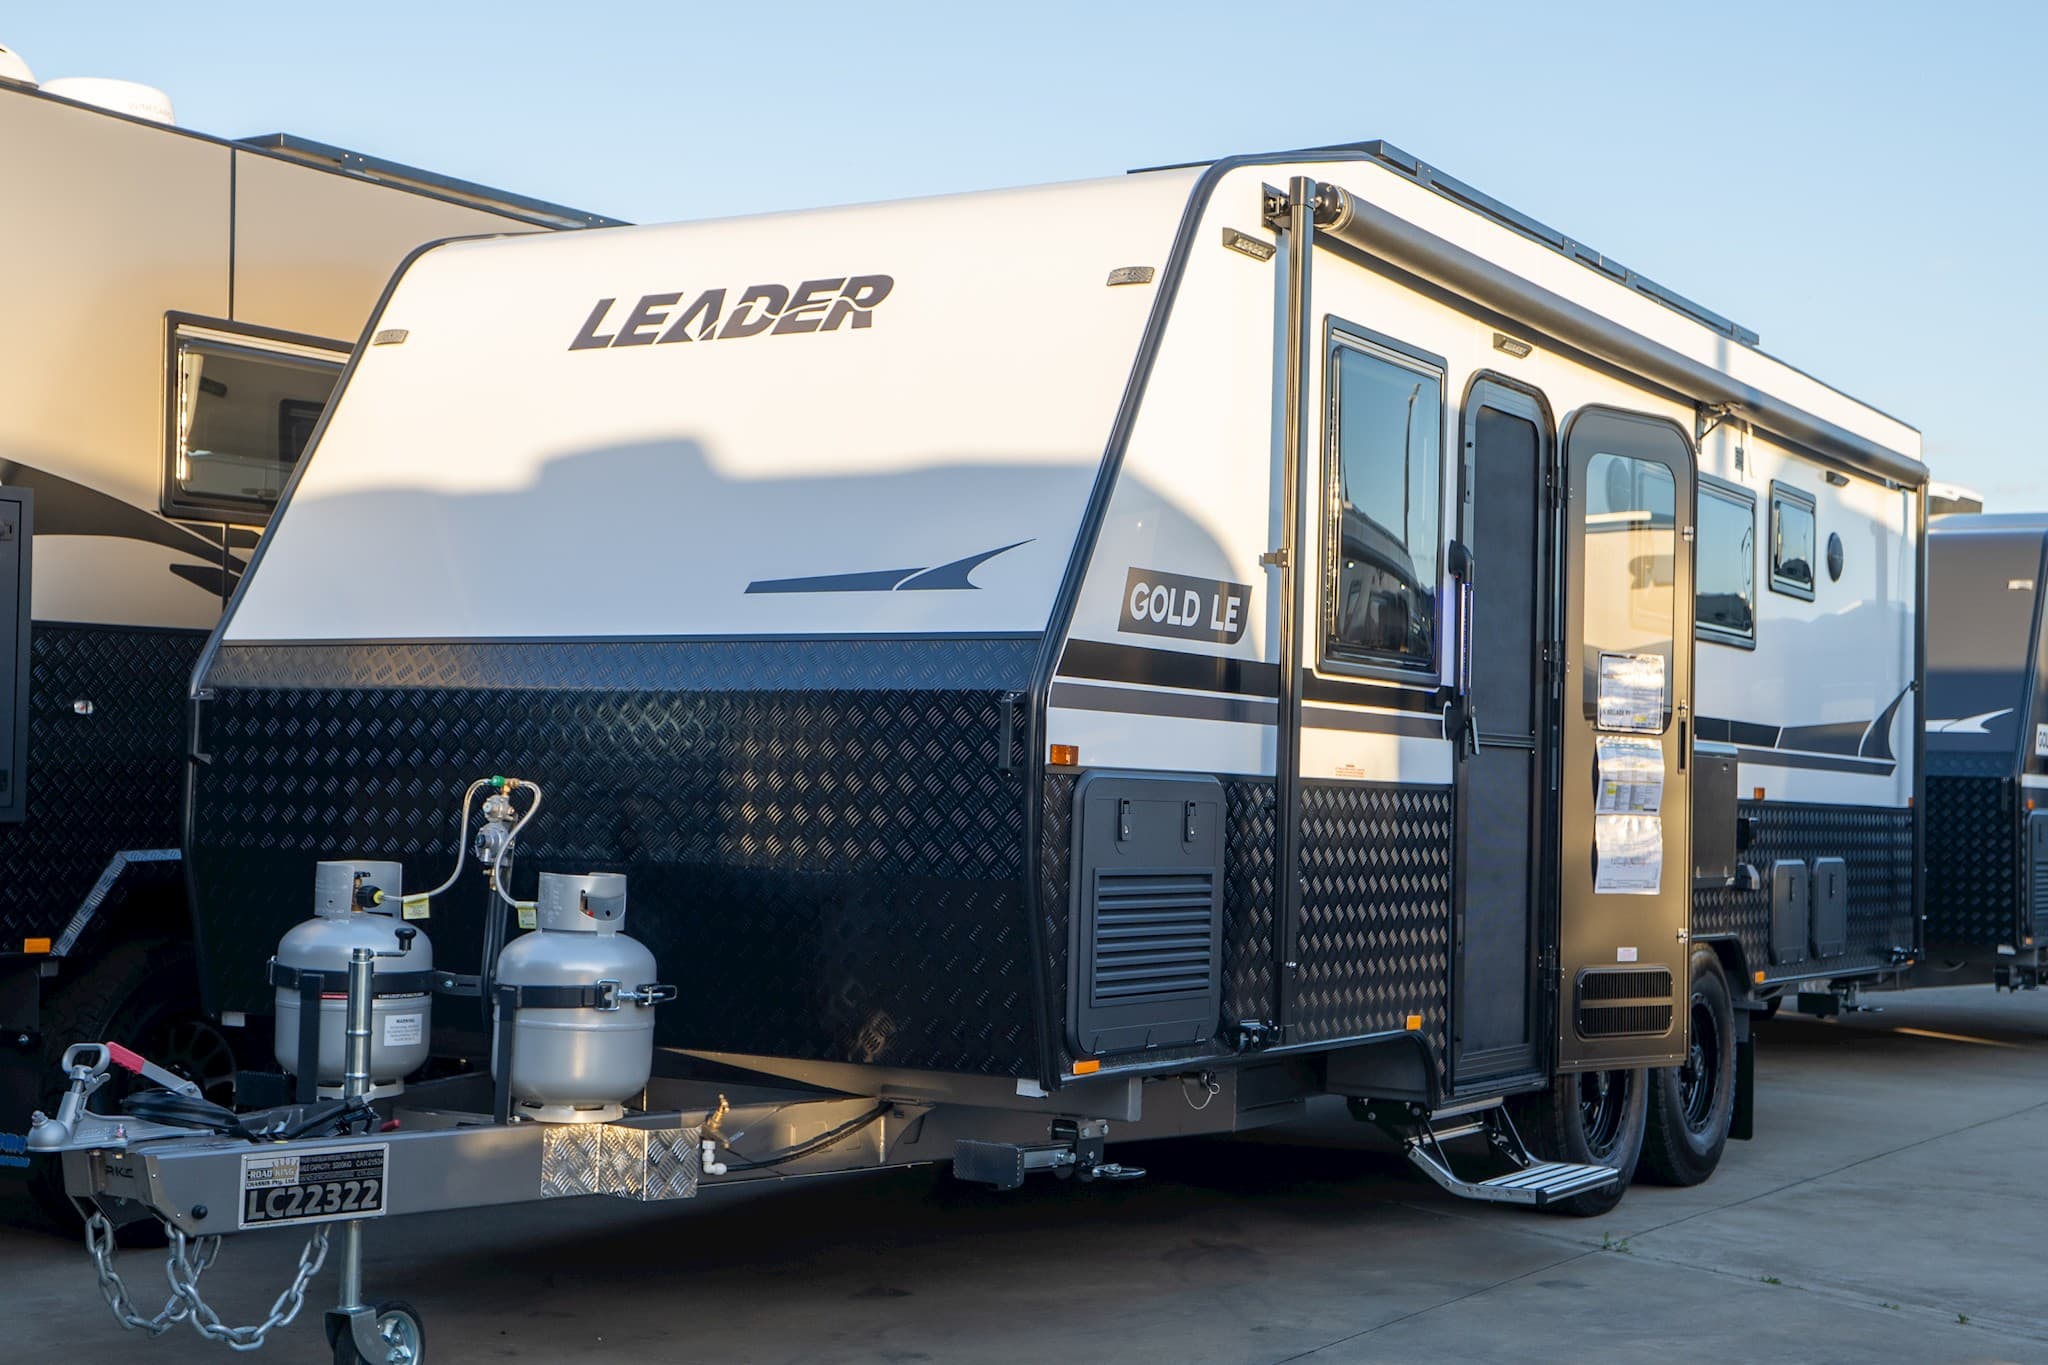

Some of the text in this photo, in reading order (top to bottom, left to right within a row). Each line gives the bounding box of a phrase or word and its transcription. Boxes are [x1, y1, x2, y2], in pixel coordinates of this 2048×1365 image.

[568, 274, 894, 351] LEADER
[1130, 582, 1241, 633] GOLD LE
[250, 1169, 273, 1179] ROAD
[274, 1168, 295, 1177] KING
[247, 1179, 379, 1221] LC22322
